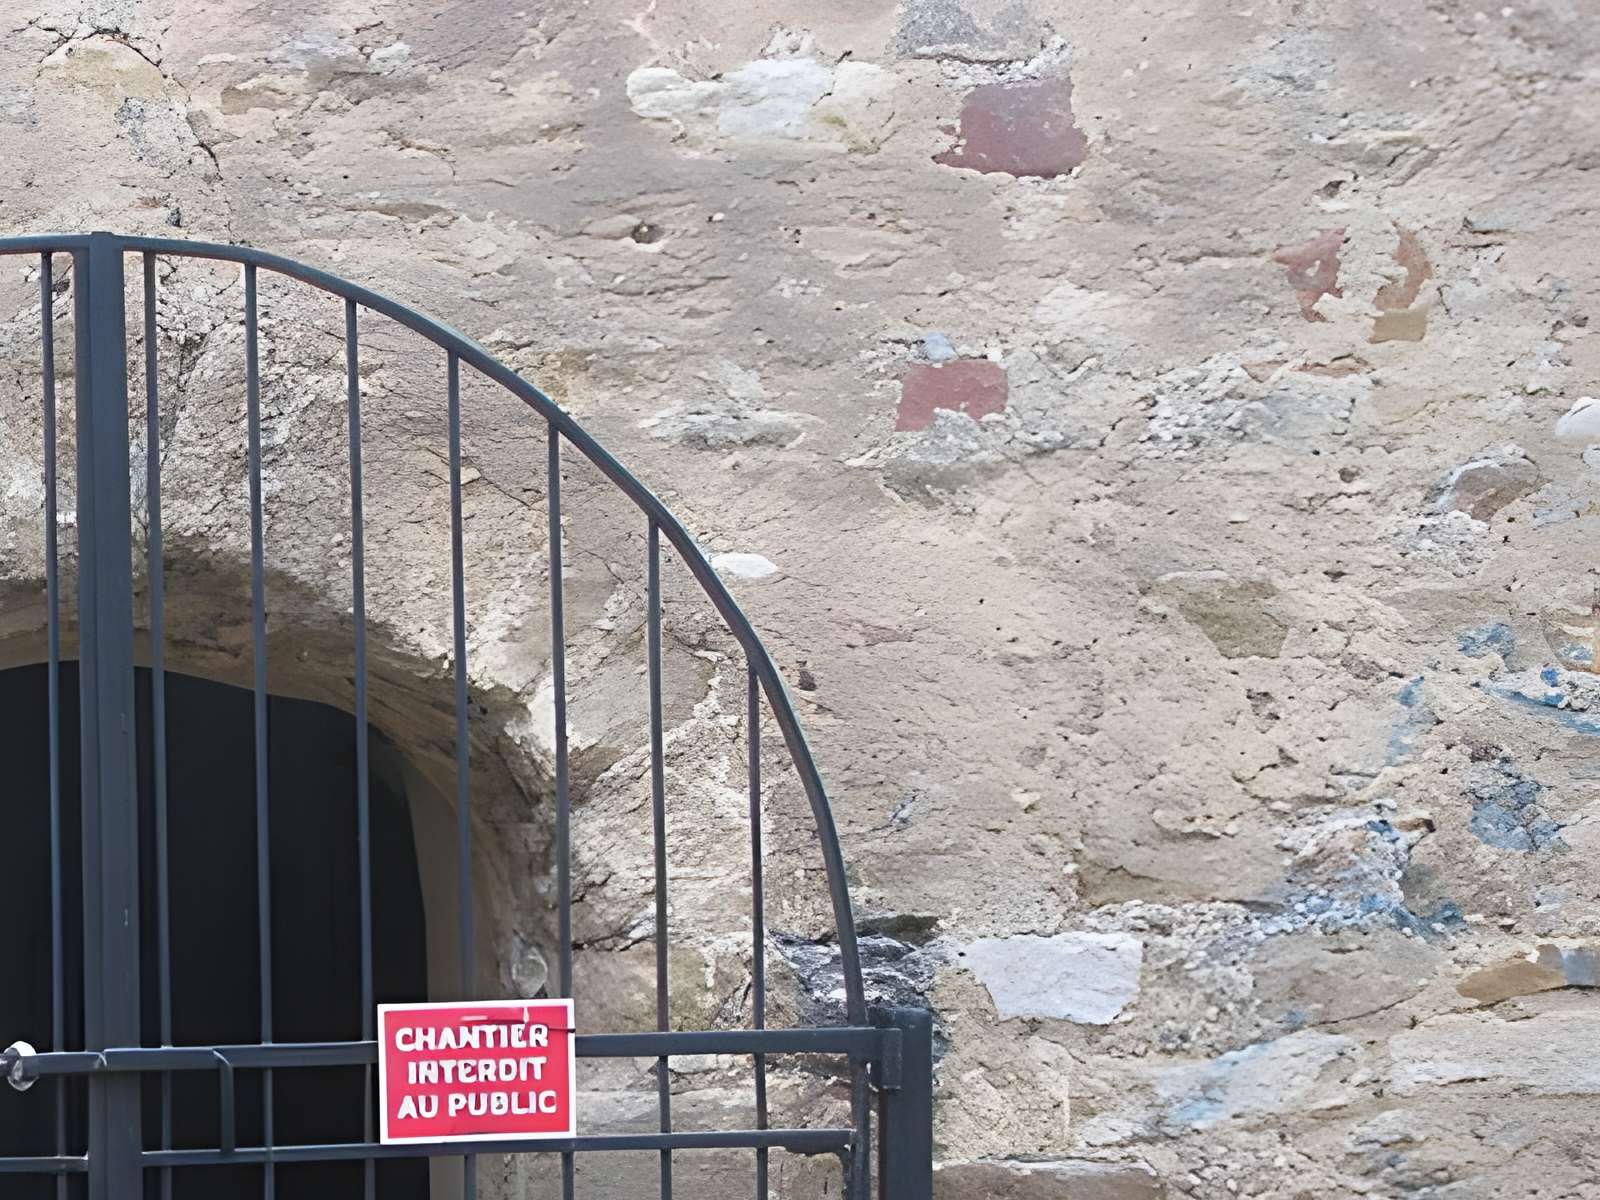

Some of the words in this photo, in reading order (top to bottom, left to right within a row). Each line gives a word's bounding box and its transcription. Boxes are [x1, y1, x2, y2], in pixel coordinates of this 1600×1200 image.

[394, 1022, 550, 1052] CHANTIER
[407, 1056, 547, 1085] INTERDIT
[397, 1094, 439, 1120] AU
[447, 1090, 558, 1118] PUBLIC
